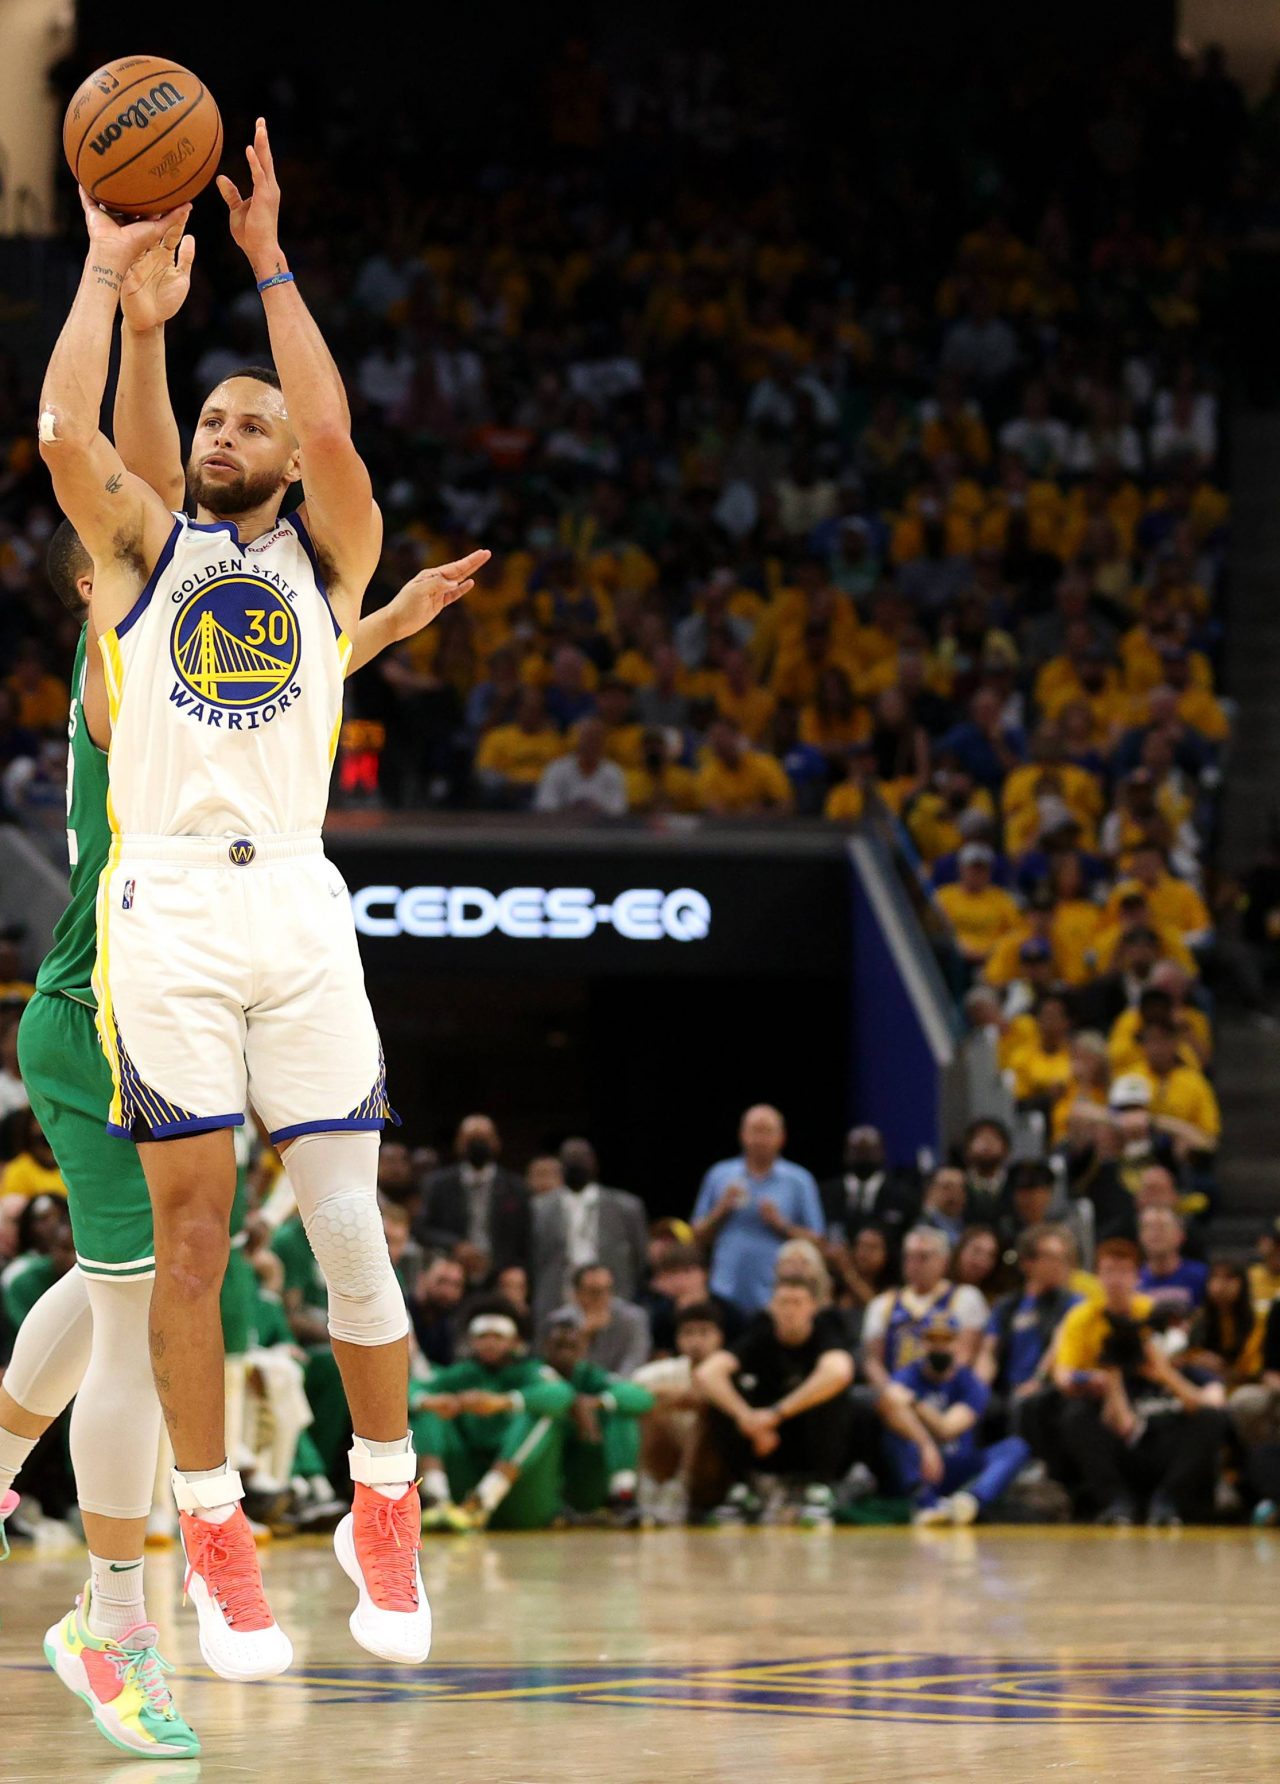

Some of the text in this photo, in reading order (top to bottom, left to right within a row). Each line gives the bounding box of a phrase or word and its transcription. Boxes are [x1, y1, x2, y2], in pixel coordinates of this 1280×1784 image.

[89, 81, 184, 156] Wilson
[247, 529, 292, 553] Rakuten
[171, 558, 298, 604] GOLDEN STATE
[244, 609, 288, 646] 30
[169, 681, 302, 730] WARRIORS
[352, 884, 711, 941] CEDES-EQ
